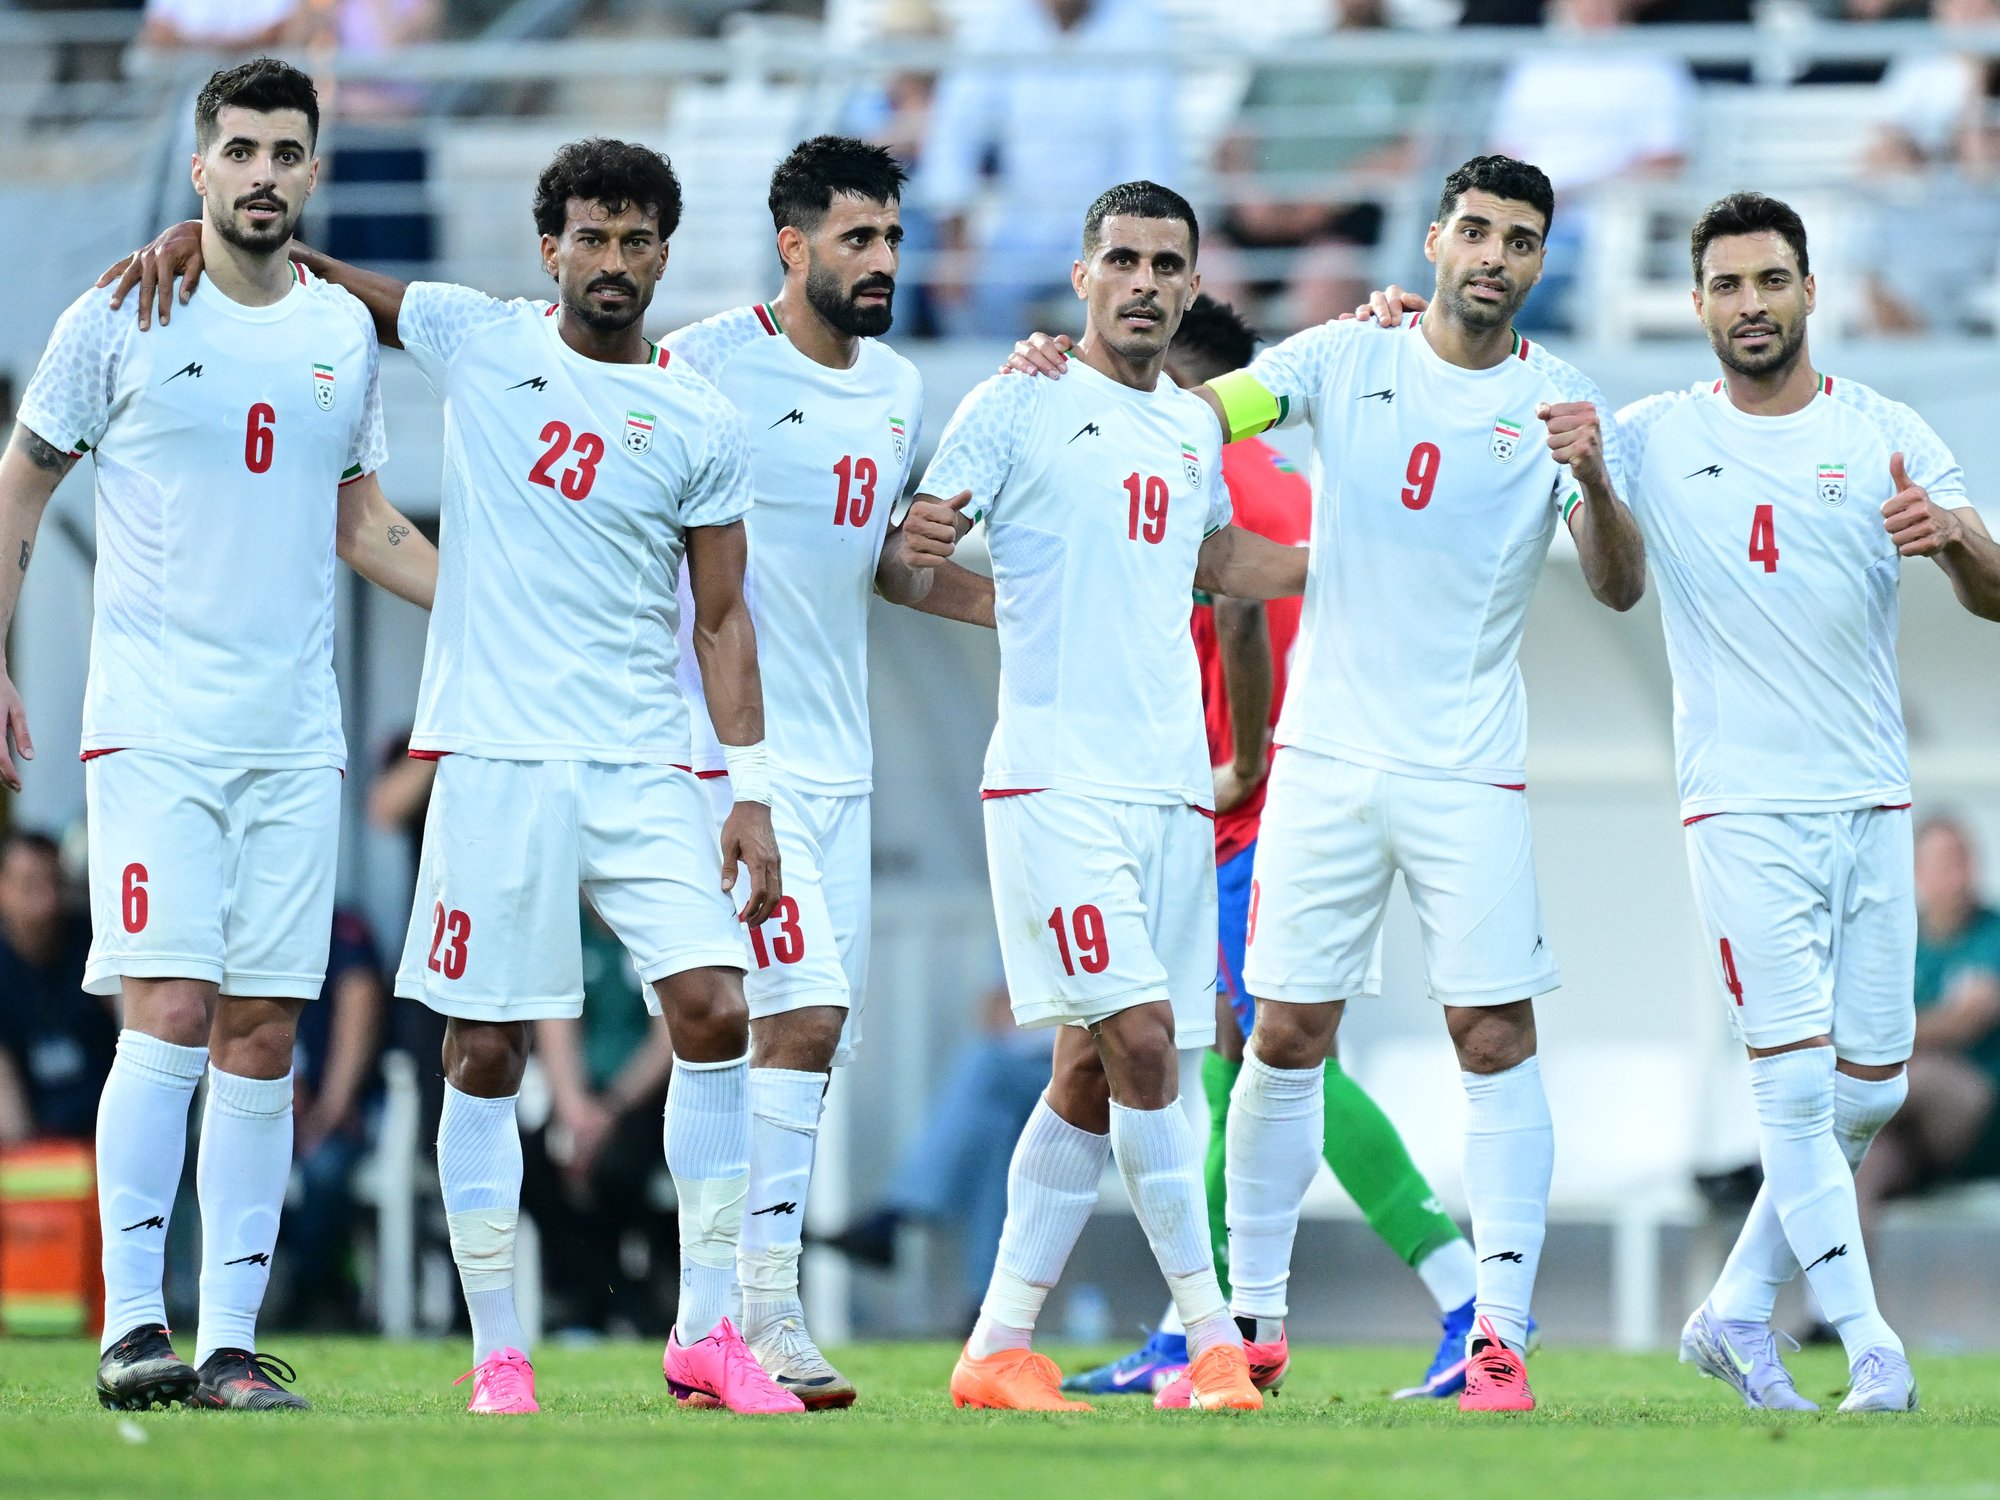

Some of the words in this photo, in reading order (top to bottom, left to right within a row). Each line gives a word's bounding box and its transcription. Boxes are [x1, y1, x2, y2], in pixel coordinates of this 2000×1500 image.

[245, 403, 275, 473] 6
[528, 420, 605, 501] 23
[833, 455, 878, 527] 13
[1123, 472, 1169, 545] 19
[1401, 442, 1441, 511] 9
[1749, 504, 1780, 573] 4
[122, 862, 149, 934] 6
[738, 895, 805, 970] 13
[428, 900, 472, 980] 23
[1048, 904, 1110, 976] 19
[1719, 937, 1743, 1006] 4
